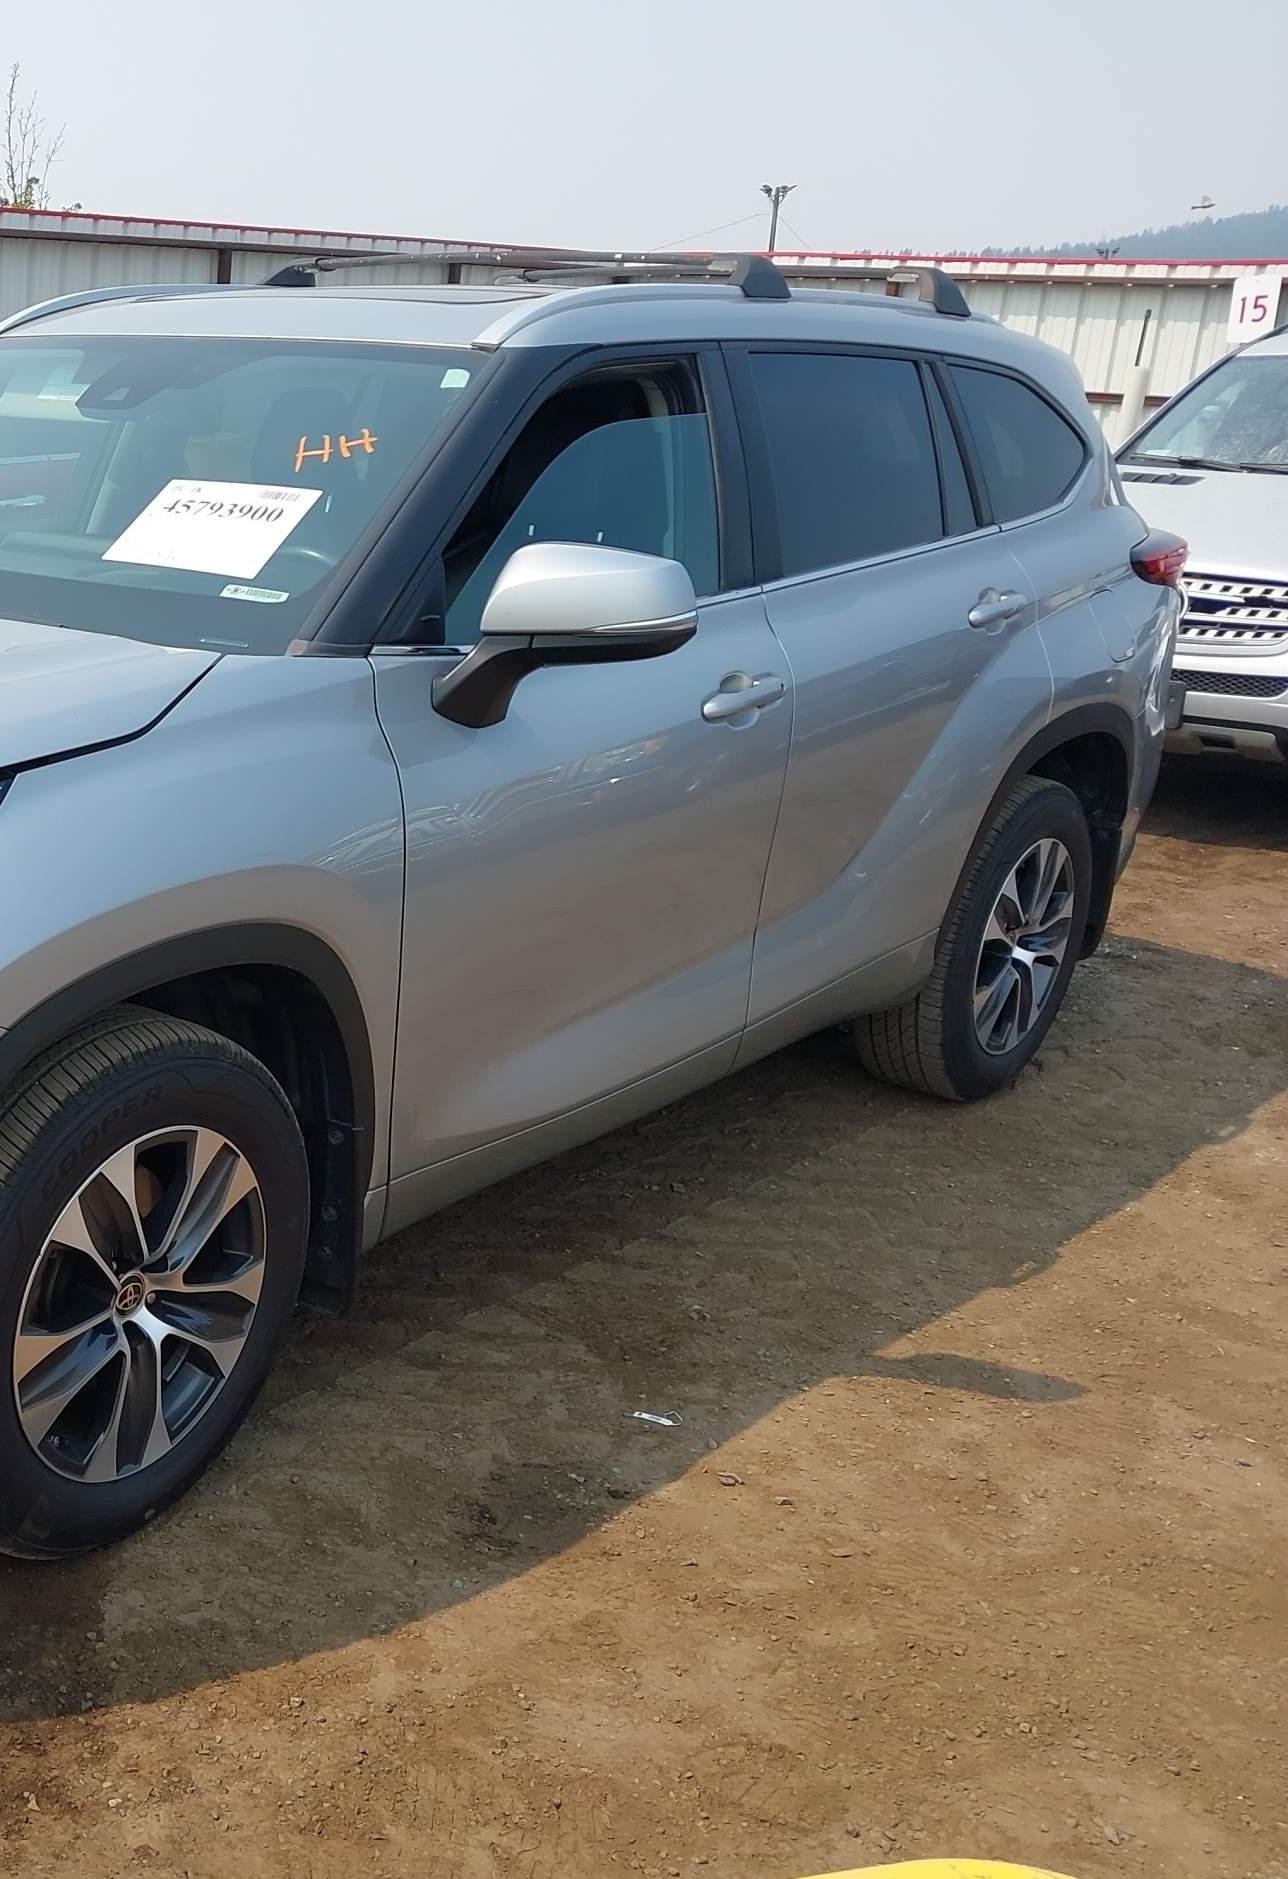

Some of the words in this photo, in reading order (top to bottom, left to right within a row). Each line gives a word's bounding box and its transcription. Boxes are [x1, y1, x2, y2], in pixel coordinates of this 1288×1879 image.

[1239, 295, 1268, 323] 15
[163, 498, 284, 523] 45793900
[40, 1086, 163, 1200] COOPER
